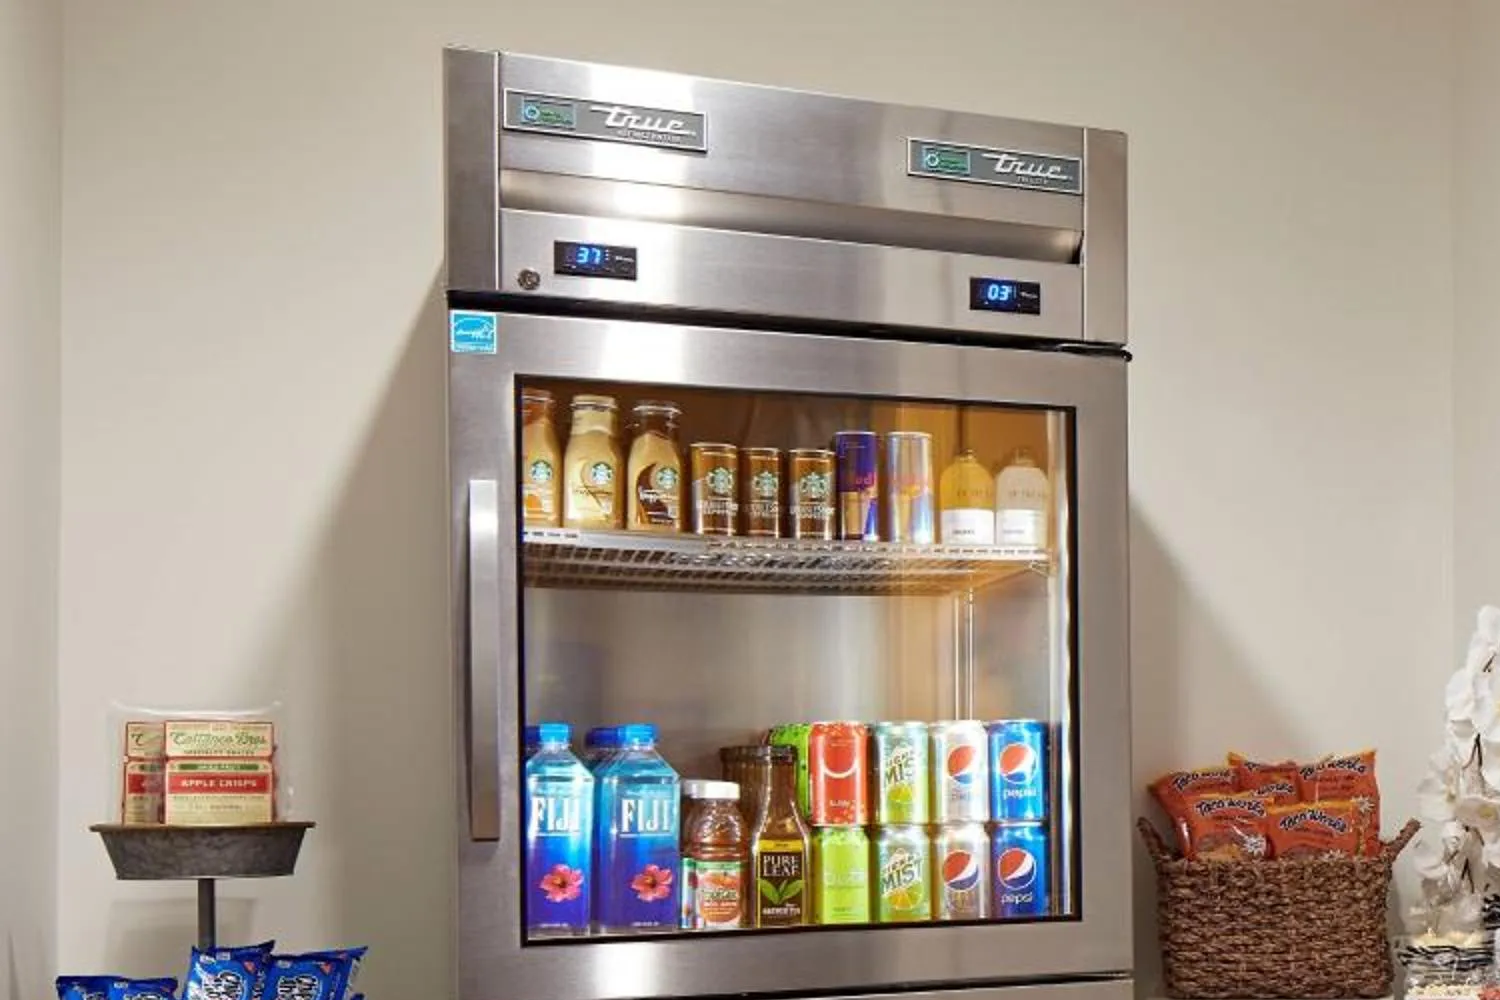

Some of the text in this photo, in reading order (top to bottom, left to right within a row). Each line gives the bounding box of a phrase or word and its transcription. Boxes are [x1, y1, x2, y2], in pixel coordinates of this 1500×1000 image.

[577, 247, 602, 264] 37
[180, 778, 257, 788] APPLE CRISPS
[533, 797, 581, 832] FIJI
[621, 799, 672, 833] FIJI
[763, 855, 801, 866] PURE
[763, 865, 800, 877] LEAF
